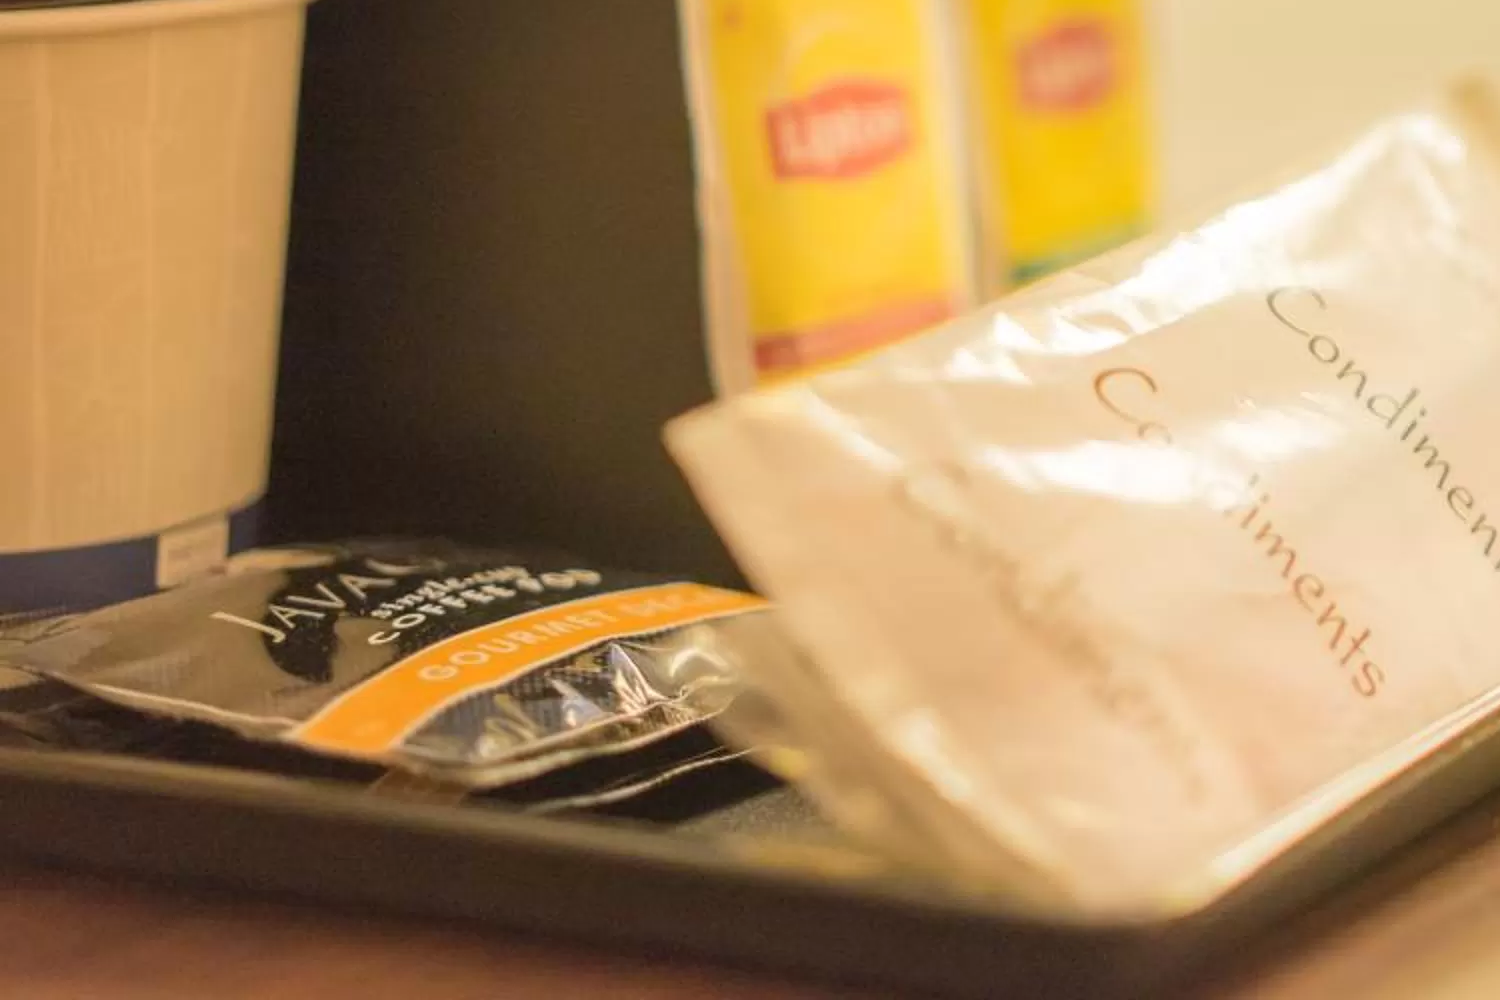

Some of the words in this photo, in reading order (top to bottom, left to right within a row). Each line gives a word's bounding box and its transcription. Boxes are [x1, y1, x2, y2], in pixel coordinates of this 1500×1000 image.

[1092, 367, 1385, 697] Coiments
[368, 584, 516, 645] COFFEE
[417, 610, 618, 681] GOURMET
